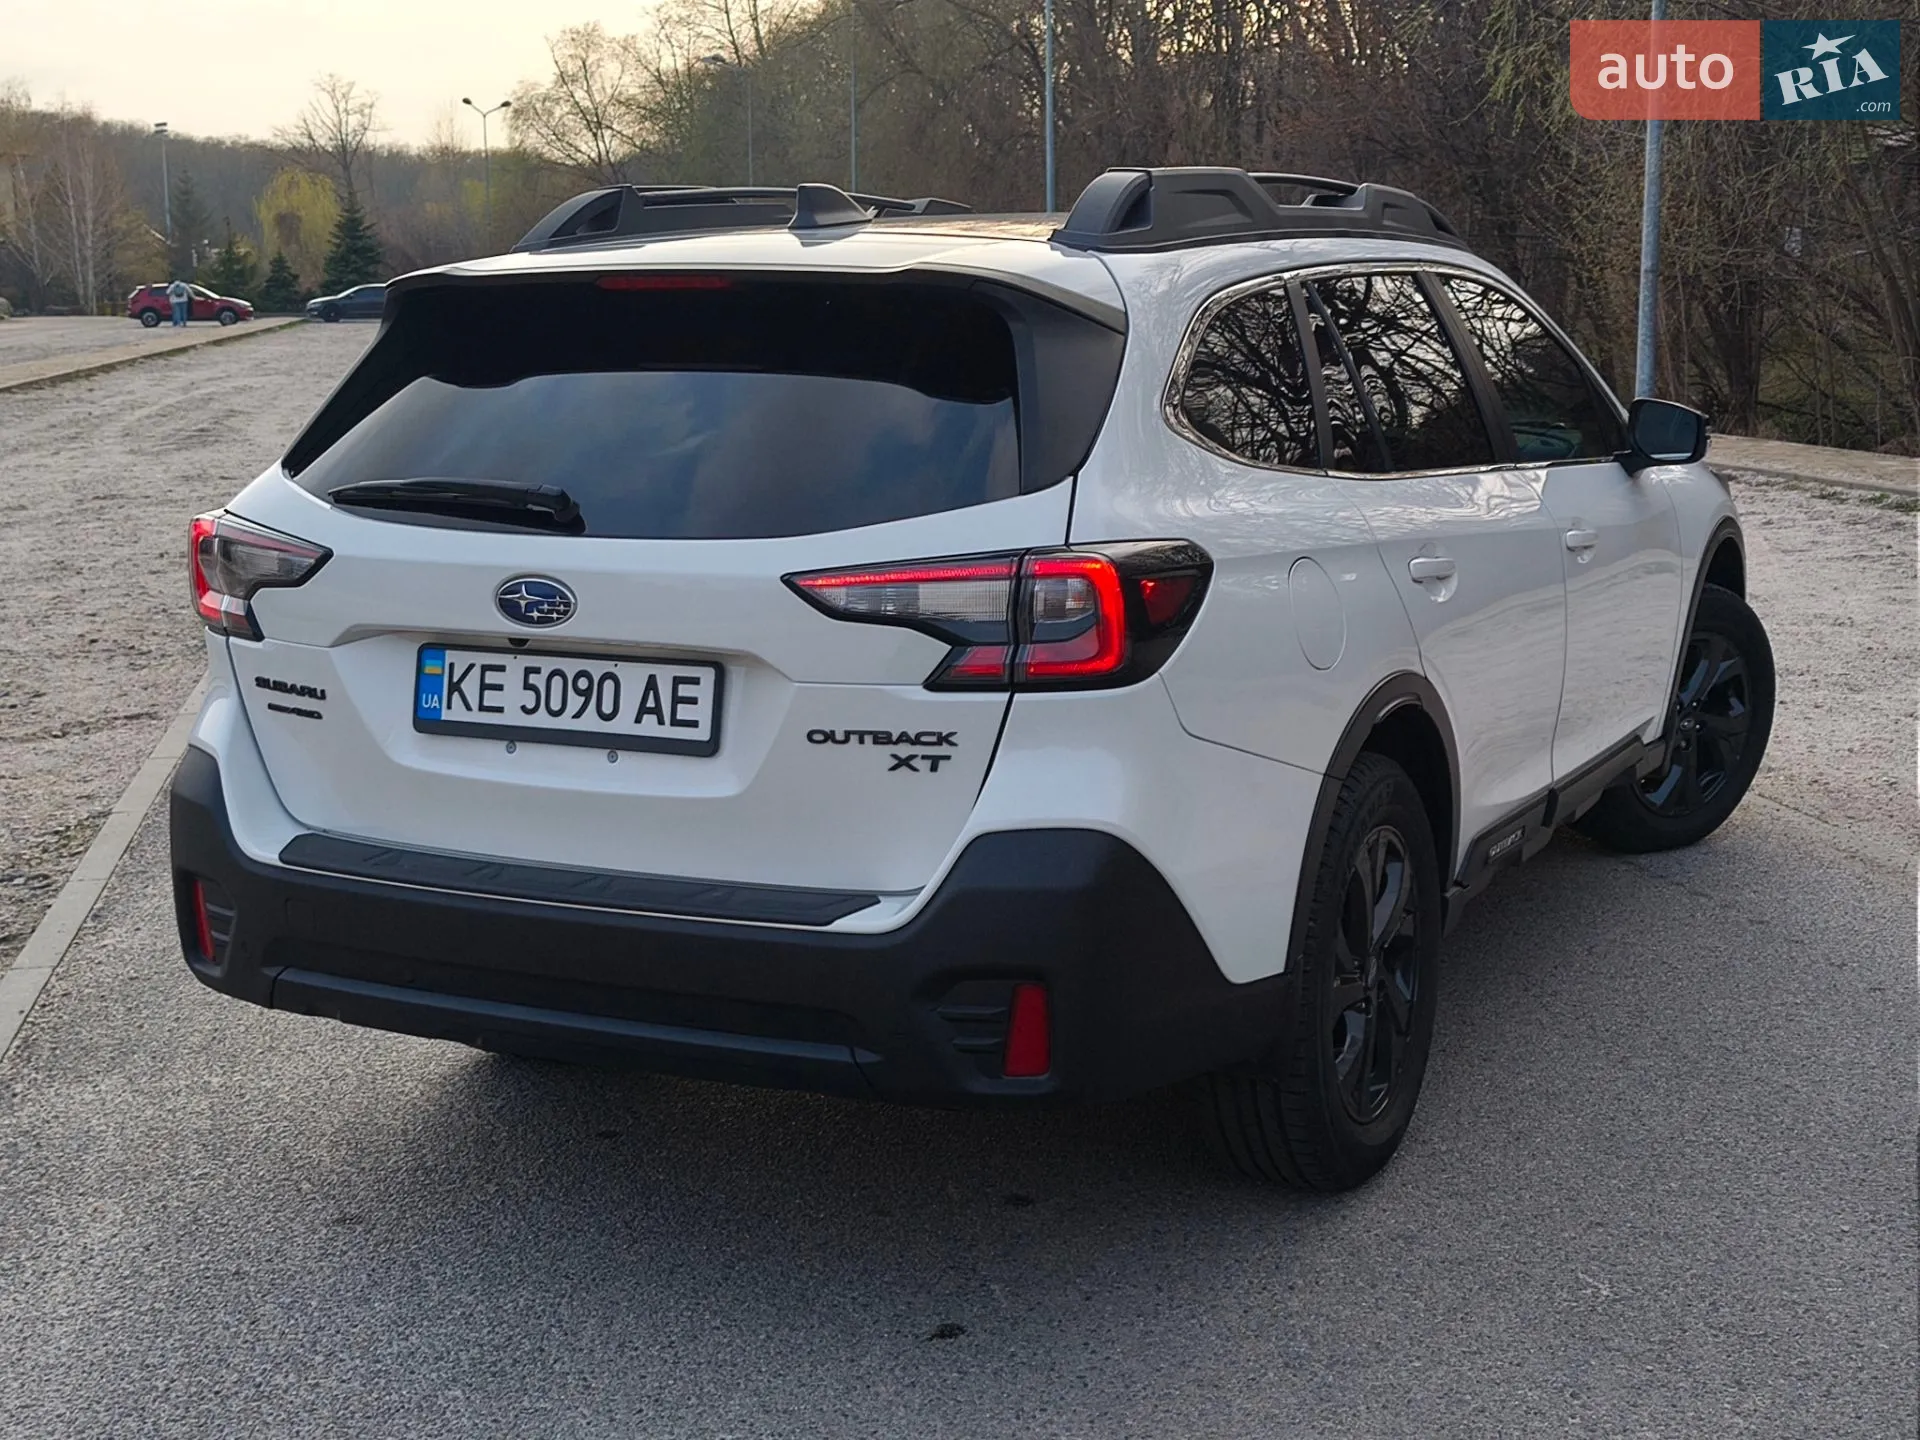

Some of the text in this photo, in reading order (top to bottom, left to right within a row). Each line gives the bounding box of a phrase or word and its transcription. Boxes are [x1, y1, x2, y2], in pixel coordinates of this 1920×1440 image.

[422, 693, 440, 709] UA
[446, 662, 701, 728] KE 5090 AE
[806, 728, 959, 747] OUTBACK
[887, 753, 952, 773] XT
